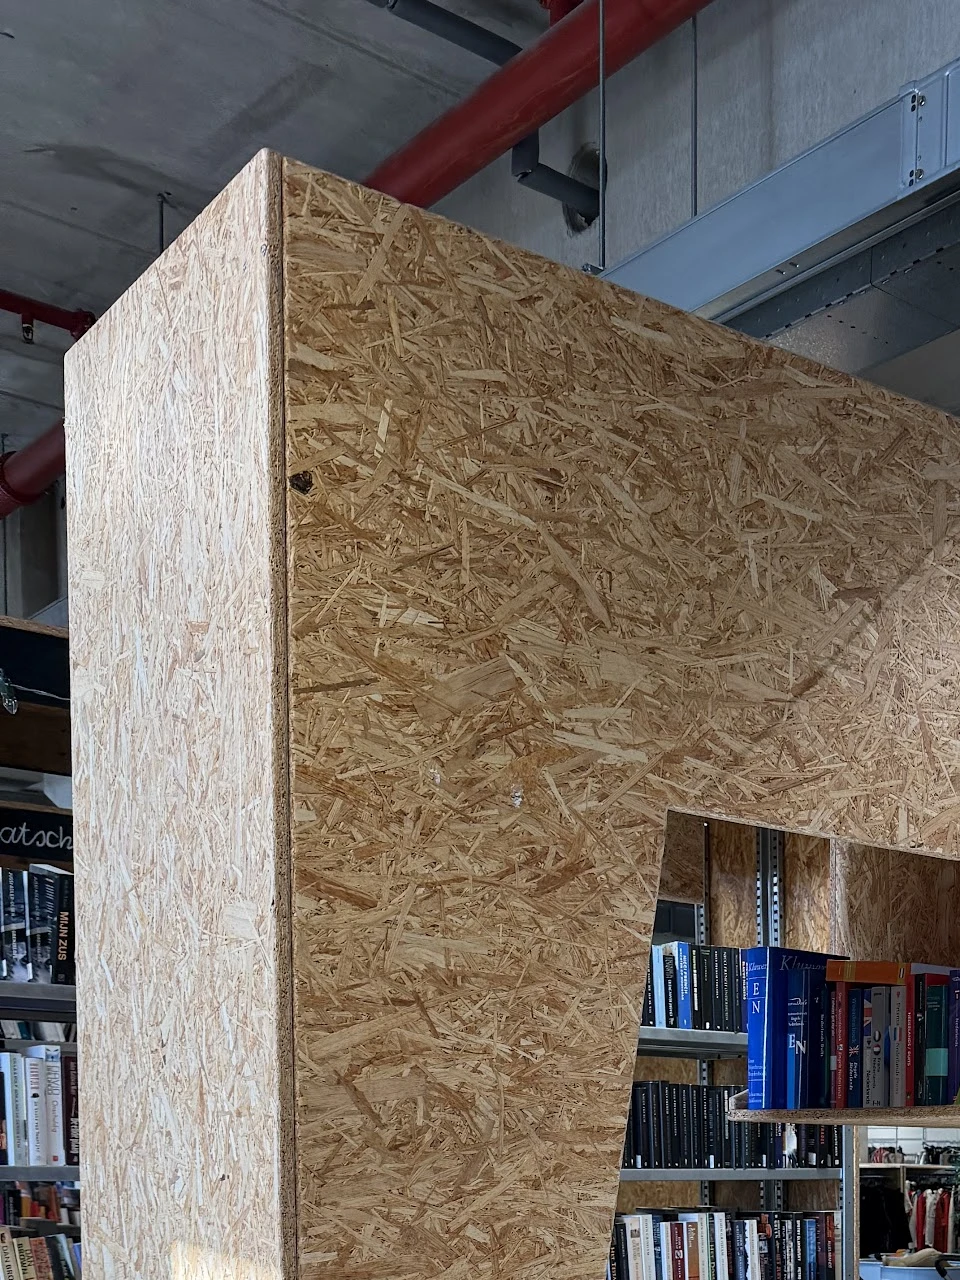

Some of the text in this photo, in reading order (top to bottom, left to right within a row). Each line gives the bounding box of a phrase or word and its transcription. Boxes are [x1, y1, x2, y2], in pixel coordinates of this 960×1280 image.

[57, 911, 69, 961] MIJN ZUS
[753, 983, 760, 995] E
[752, 1001, 761, 1013] N
[789, 1034, 795, 1048] E
[796, 1040, 806, 1055] N
[1, 1246, 10, 1263] DAN
[17, 1243, 28, 1274] BROWN
[25, 1249, 34, 1266] DAN
